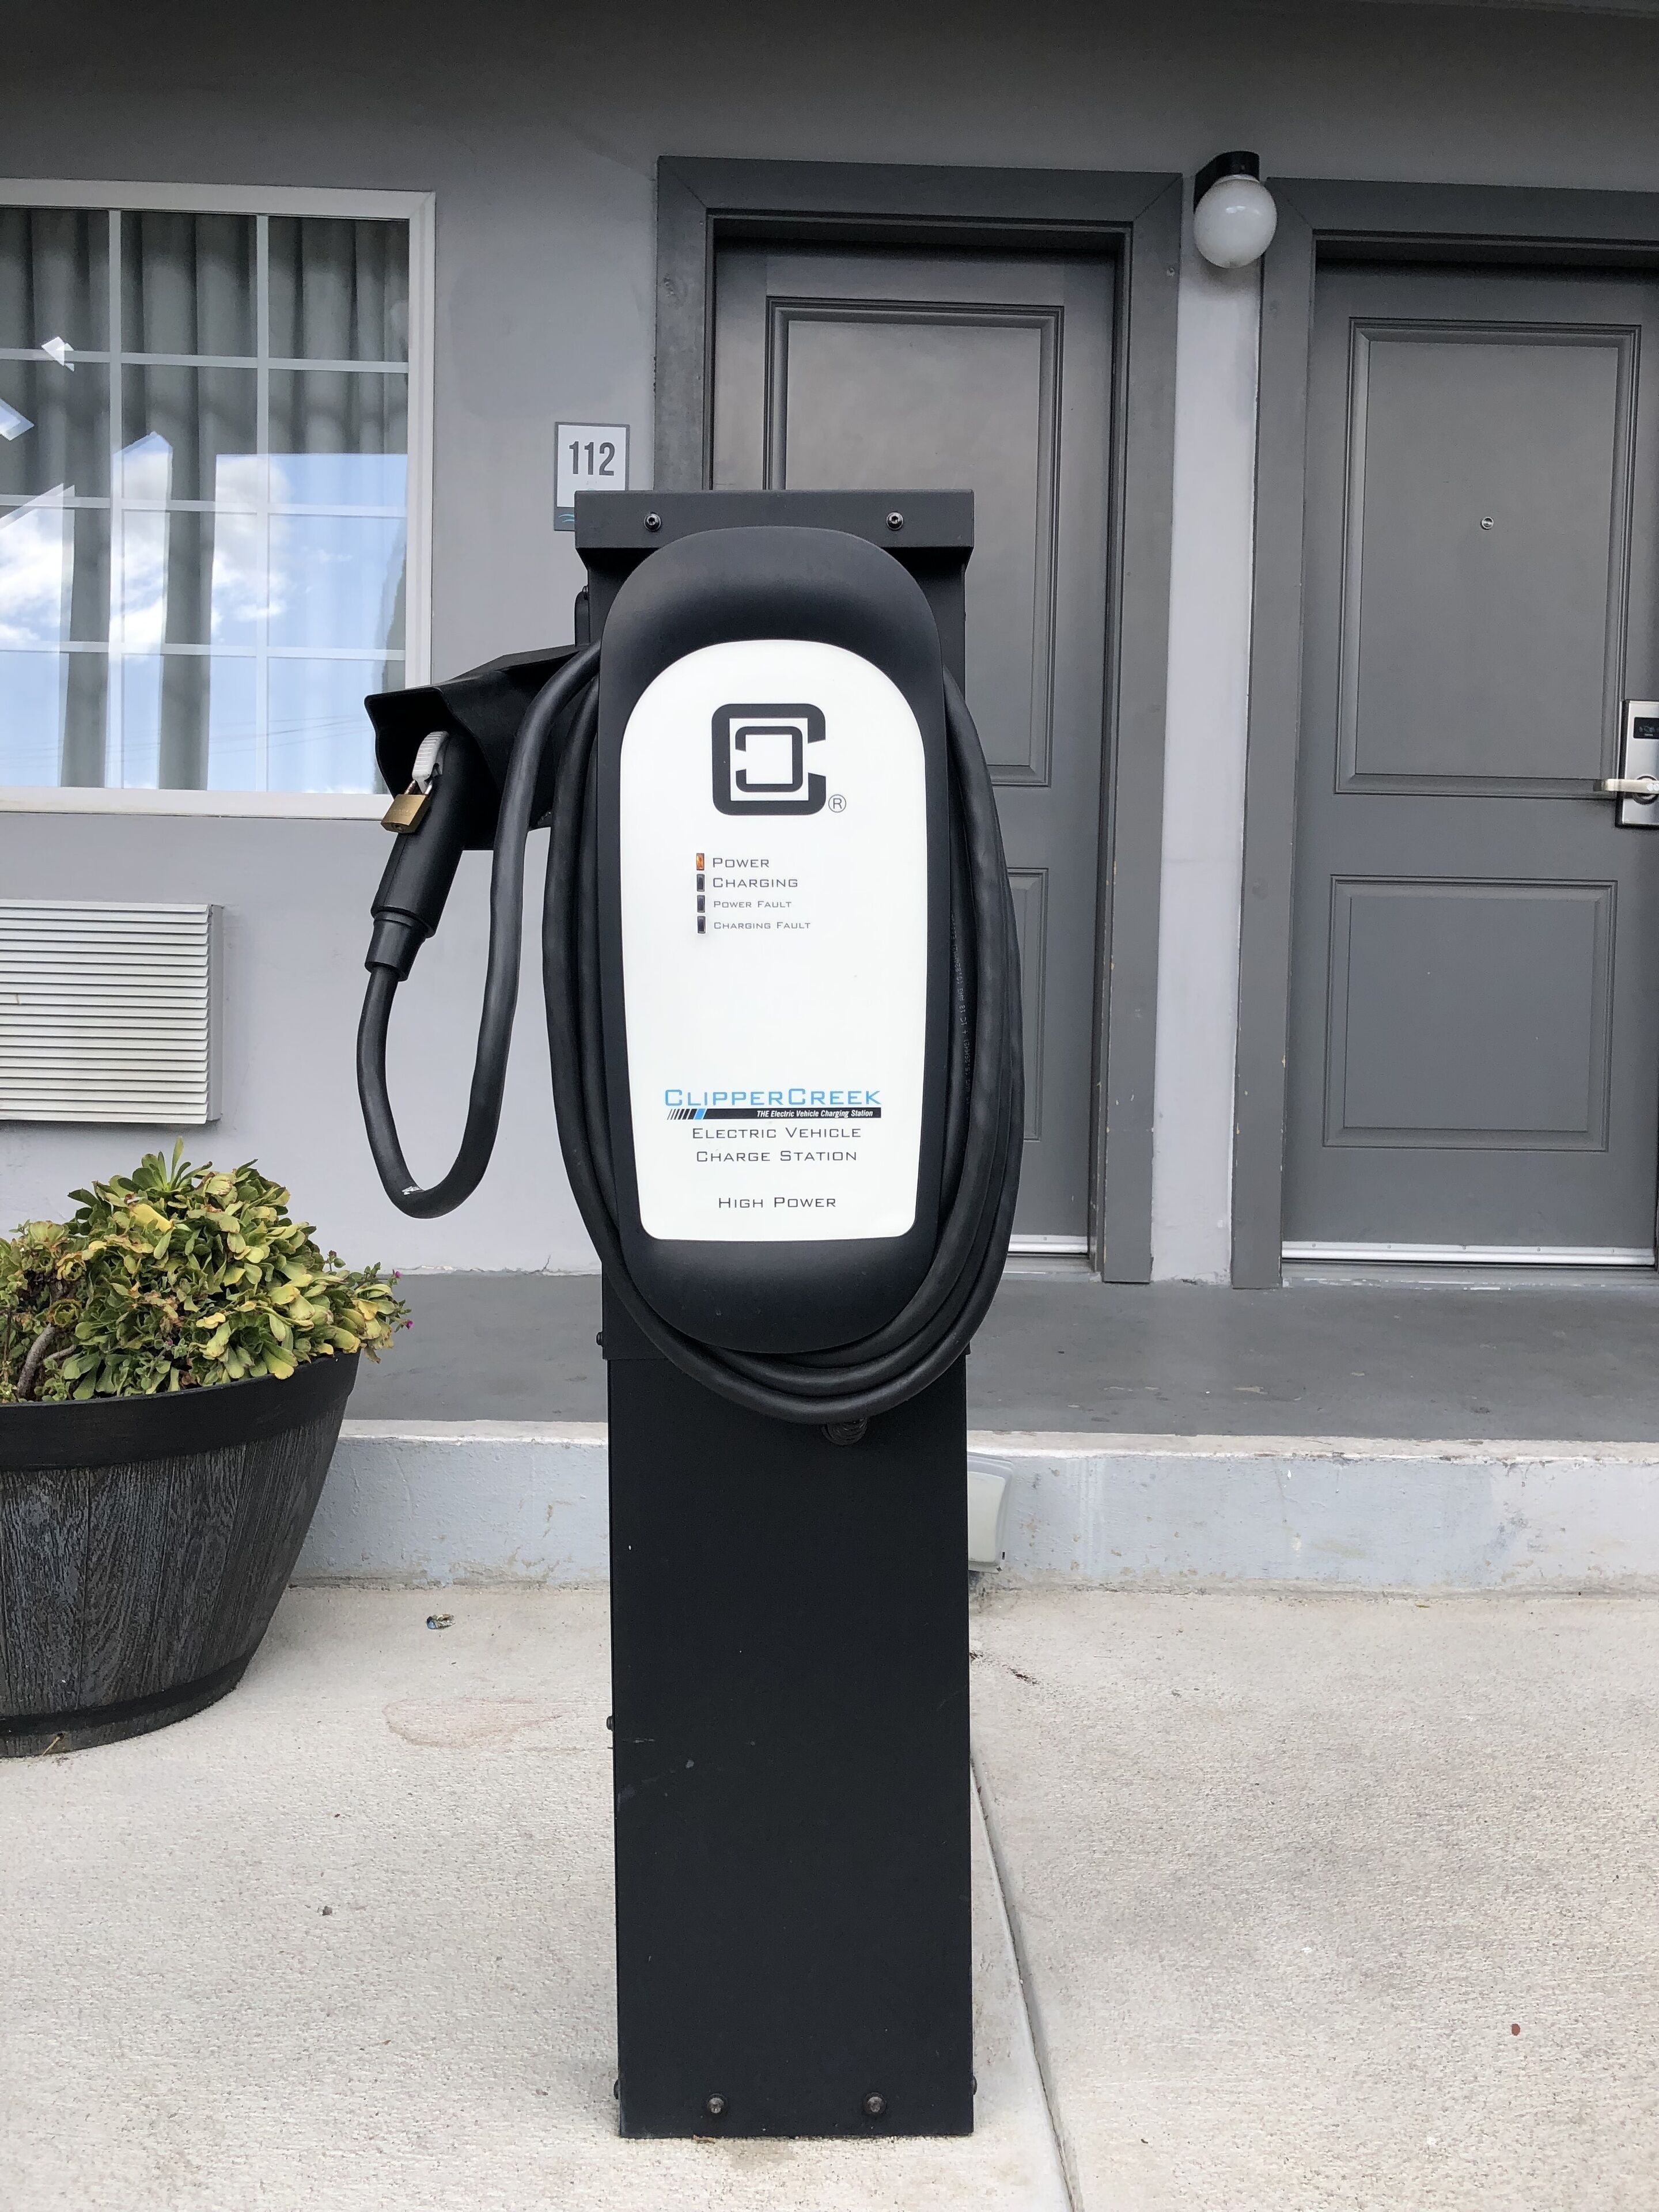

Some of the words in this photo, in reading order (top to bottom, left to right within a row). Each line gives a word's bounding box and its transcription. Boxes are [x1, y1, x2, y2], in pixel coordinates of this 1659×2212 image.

[569, 441, 615, 476] 112
[713, 857, 770, 868] POWER
[713, 877, 798, 888] CHARGING
[713, 900, 752, 908] POWER
[714, 922, 771, 930] CHARGING
[756, 1109, 769, 1118] THE
[796, 1109, 819, 1118] Vehicle
[820, 1109, 849, 1119] Charging
[850, 1109, 873, 1117] Station
[692, 1128, 777, 1139] ELECTRIC
[785, 1127, 861, 1138] VEHICLE
[696, 1151, 771, 1162] CHARGE
[780, 1150, 857, 1161] STATION
[718, 1197, 763, 1209] HIGH
[774, 1197, 836, 1208] POWER
